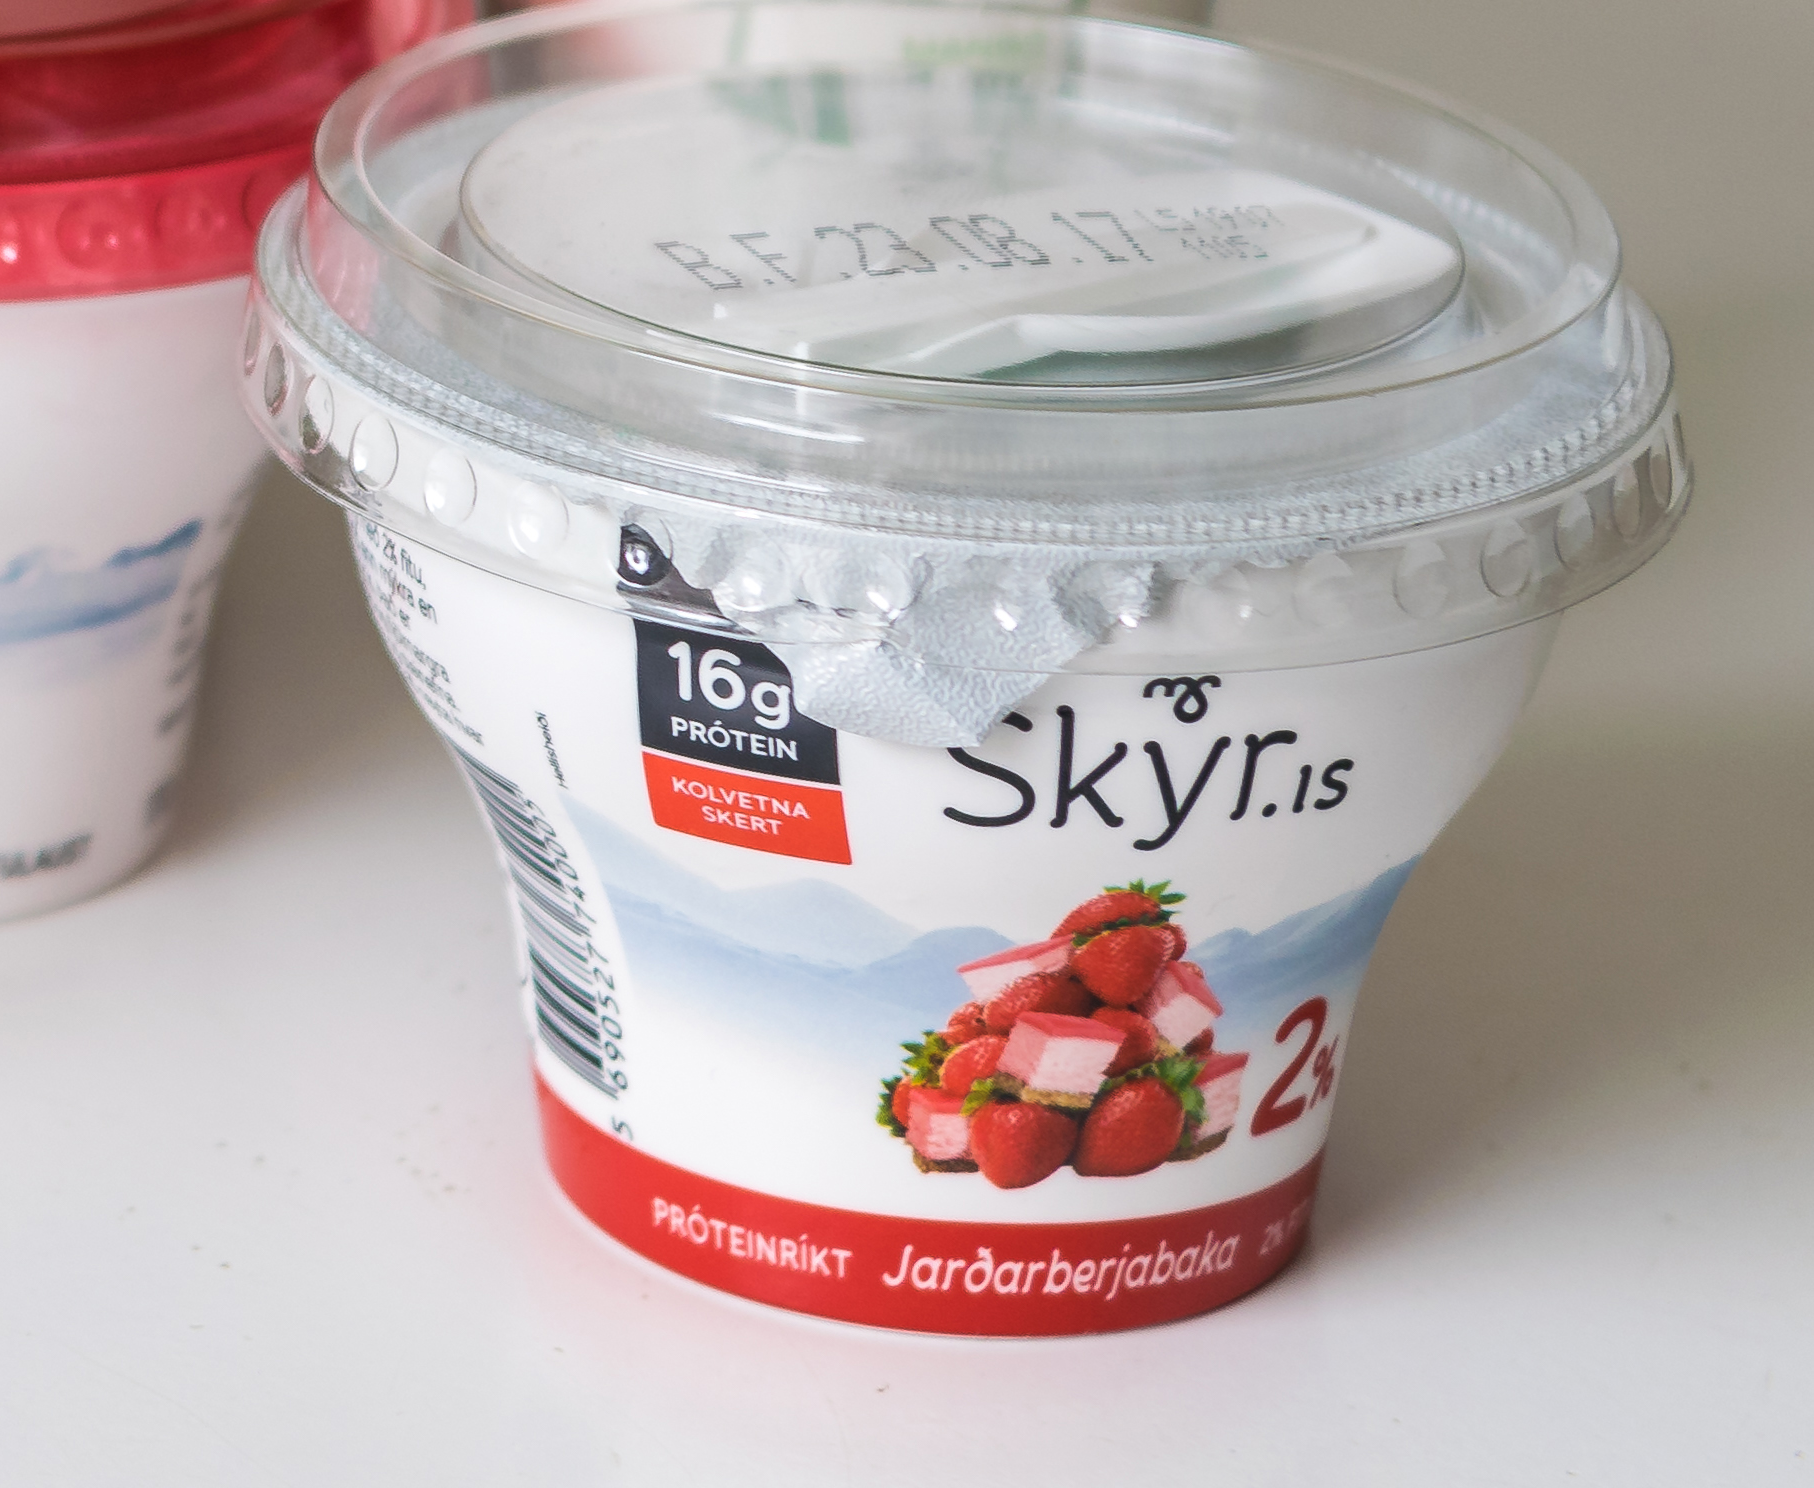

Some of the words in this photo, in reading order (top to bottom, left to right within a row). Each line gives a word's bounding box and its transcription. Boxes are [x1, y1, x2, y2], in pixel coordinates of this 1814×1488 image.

[668, 641, 792, 731] 16g
[671, 715, 799, 762] PRÓTEIN
[671, 776, 810, 821] KOLVETNA
[702, 805, 784, 836] SKERT
[653, 1196, 853, 1281] PRÓTEINRÍKT
[883, 1229, 1239, 1302] Jarðarberjabaka
